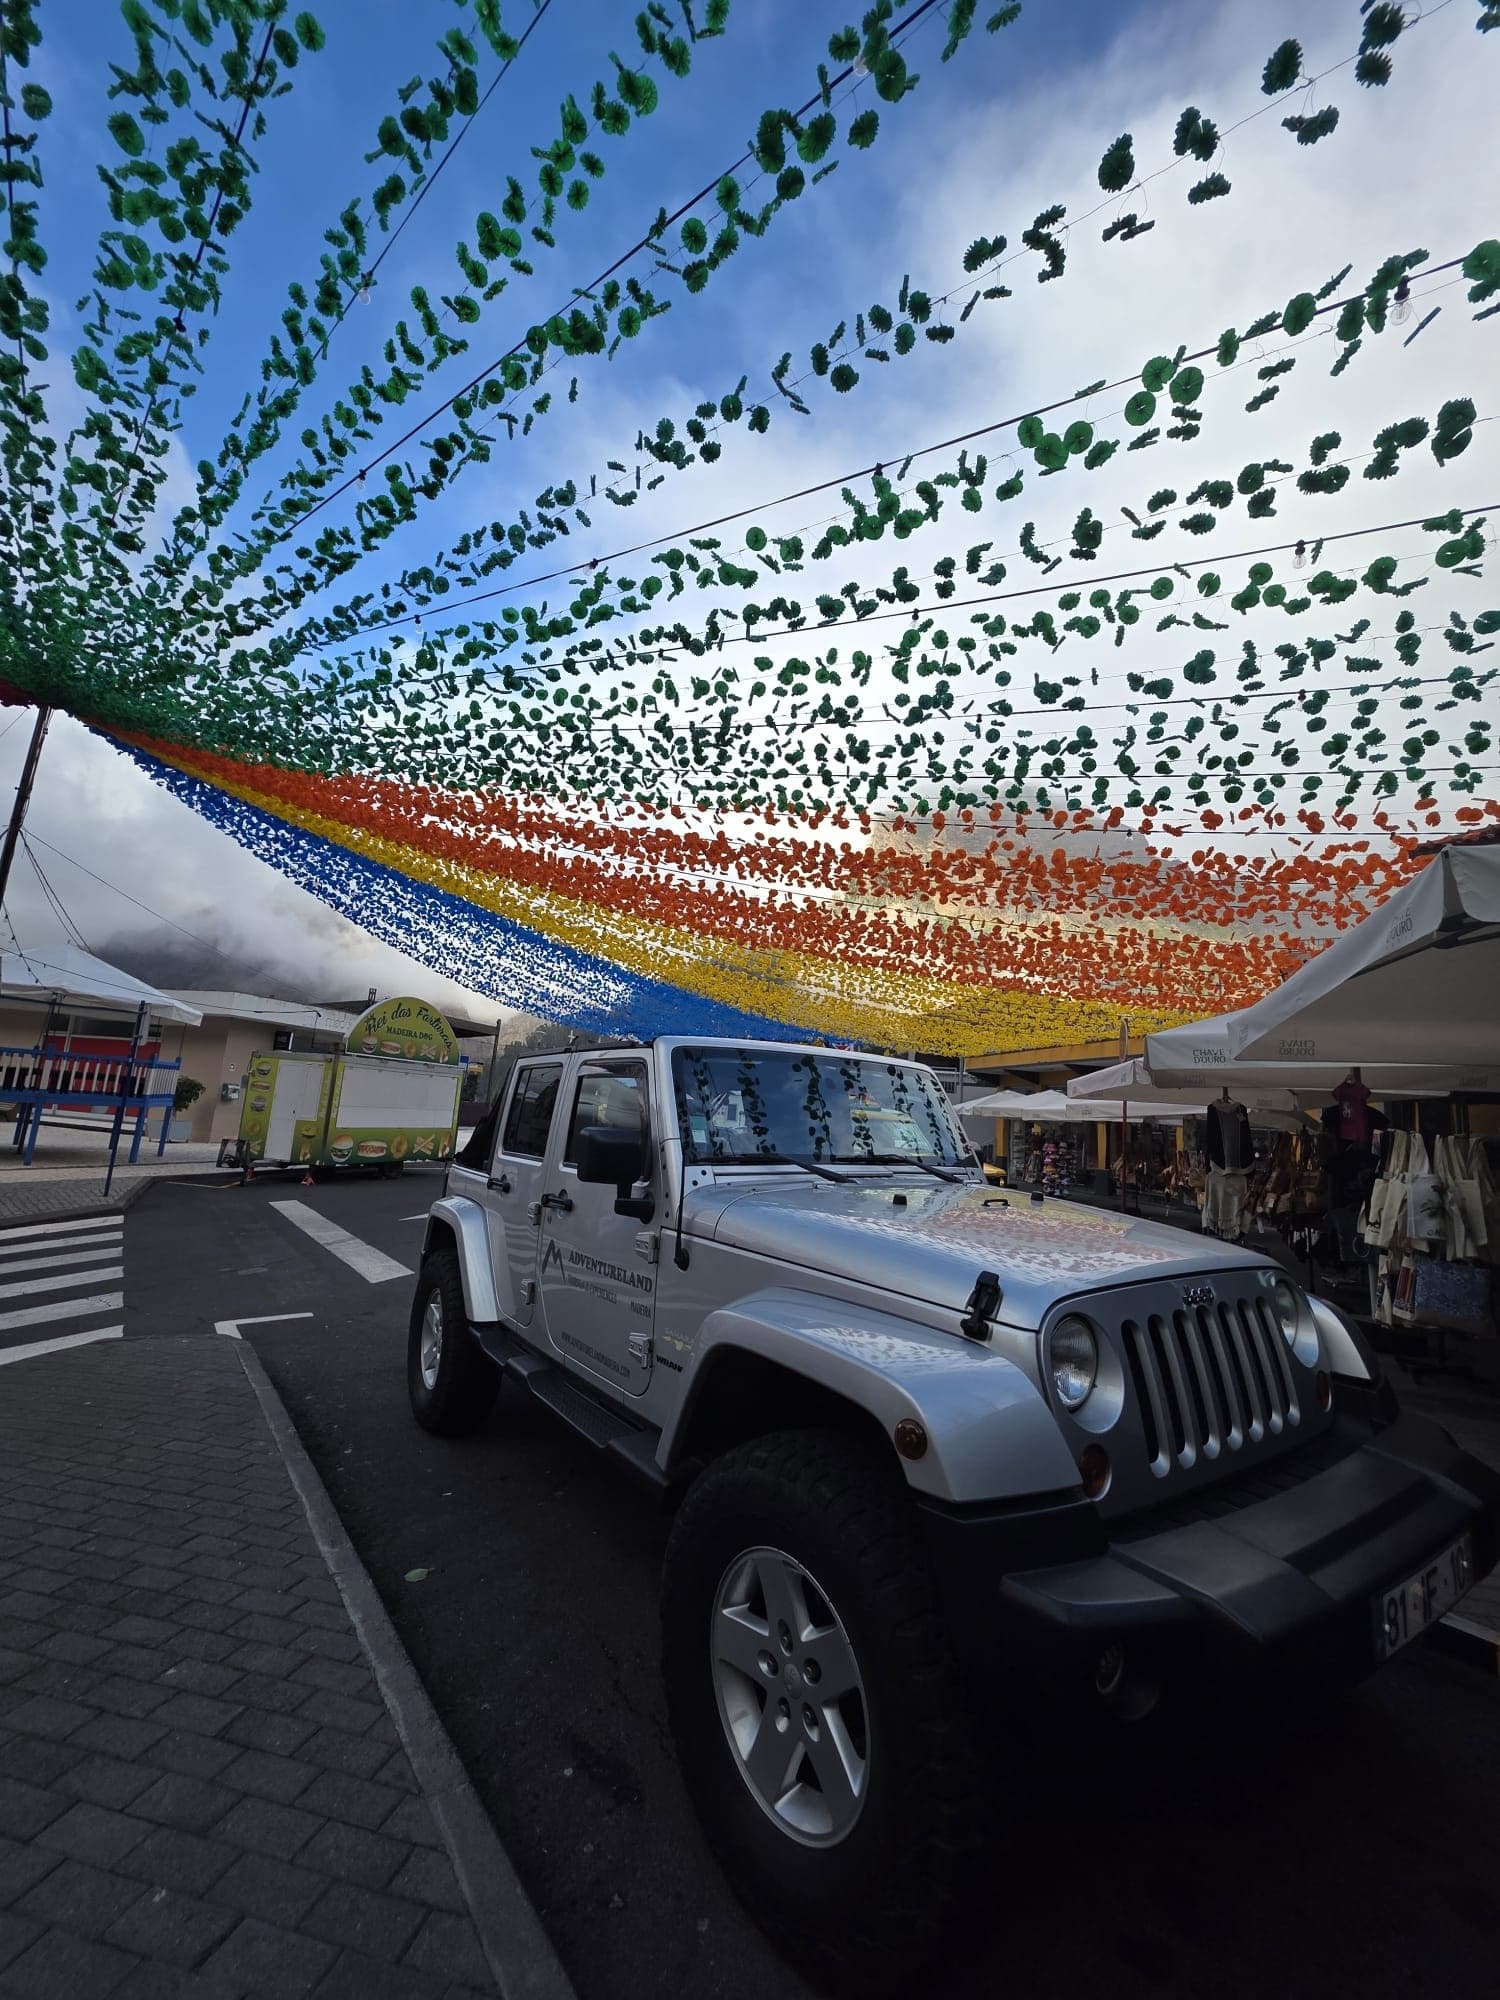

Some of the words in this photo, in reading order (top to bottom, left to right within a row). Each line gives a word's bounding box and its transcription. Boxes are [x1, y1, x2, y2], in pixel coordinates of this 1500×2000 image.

[386, 1026, 418, 1039] MADEIRA
[418, 1031, 433, 1041] DOG
[391, 1002, 412, 1021] das
[416, 1006, 452, 1050] Farturas
[1192, 1048, 1224, 1057] CHAVE
[1193, 1056, 1226, 1064] D'OURO
[568, 1250, 653, 1293] ADVENTURELAND
[630, 1301, 652, 1318] MADEIRA
